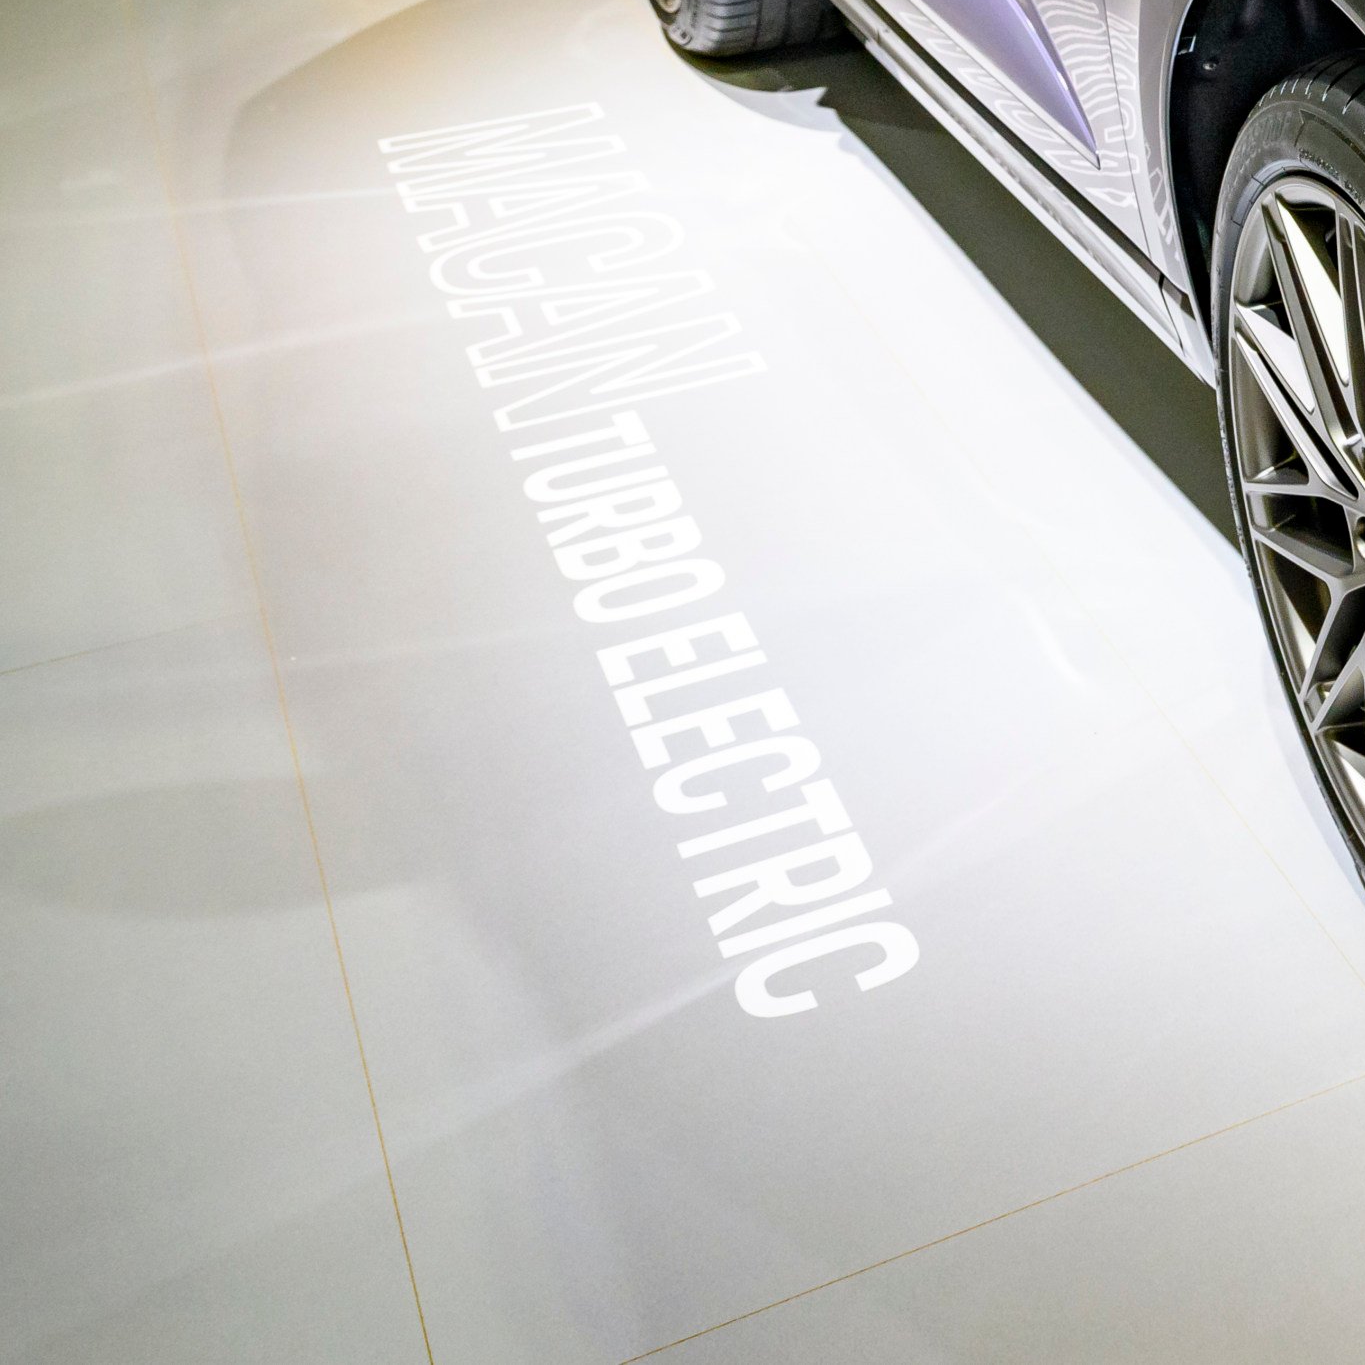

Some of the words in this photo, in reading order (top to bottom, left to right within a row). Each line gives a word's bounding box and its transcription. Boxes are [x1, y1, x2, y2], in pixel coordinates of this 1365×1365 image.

[377, 101, 769, 433] MACAN
[509, 409, 727, 624] TURBO
[595, 611, 921, 1020] ELECTRIC
